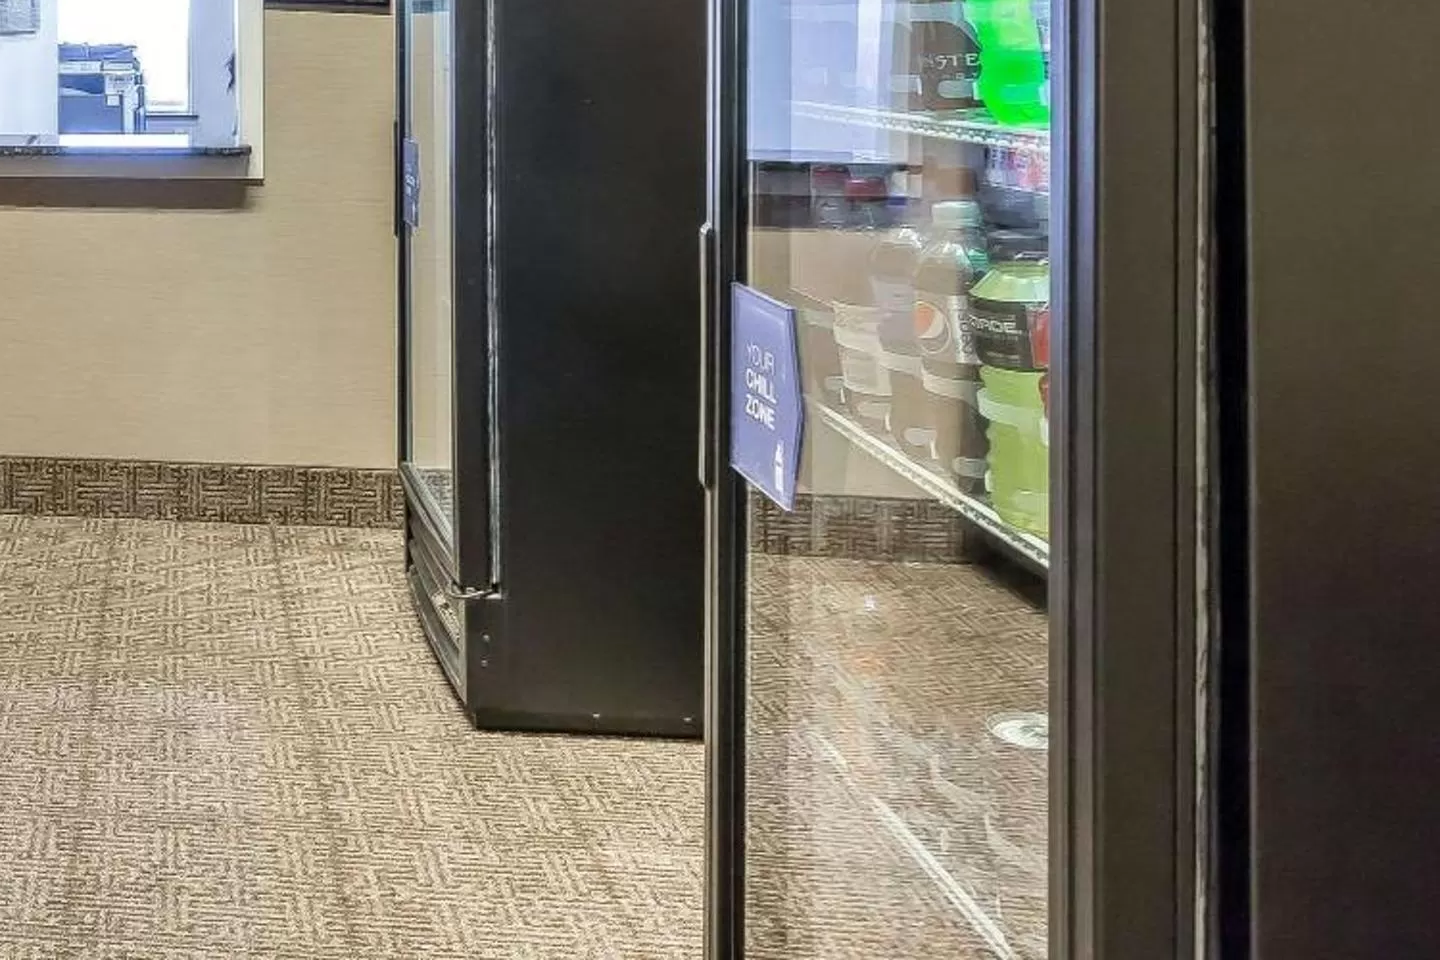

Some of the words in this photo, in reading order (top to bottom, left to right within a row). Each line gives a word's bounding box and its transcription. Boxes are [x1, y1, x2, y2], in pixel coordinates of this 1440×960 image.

[746, 342, 775, 375] YOUR
[745, 368, 777, 404] CHILL
[745, 393, 776, 431] ZONE
